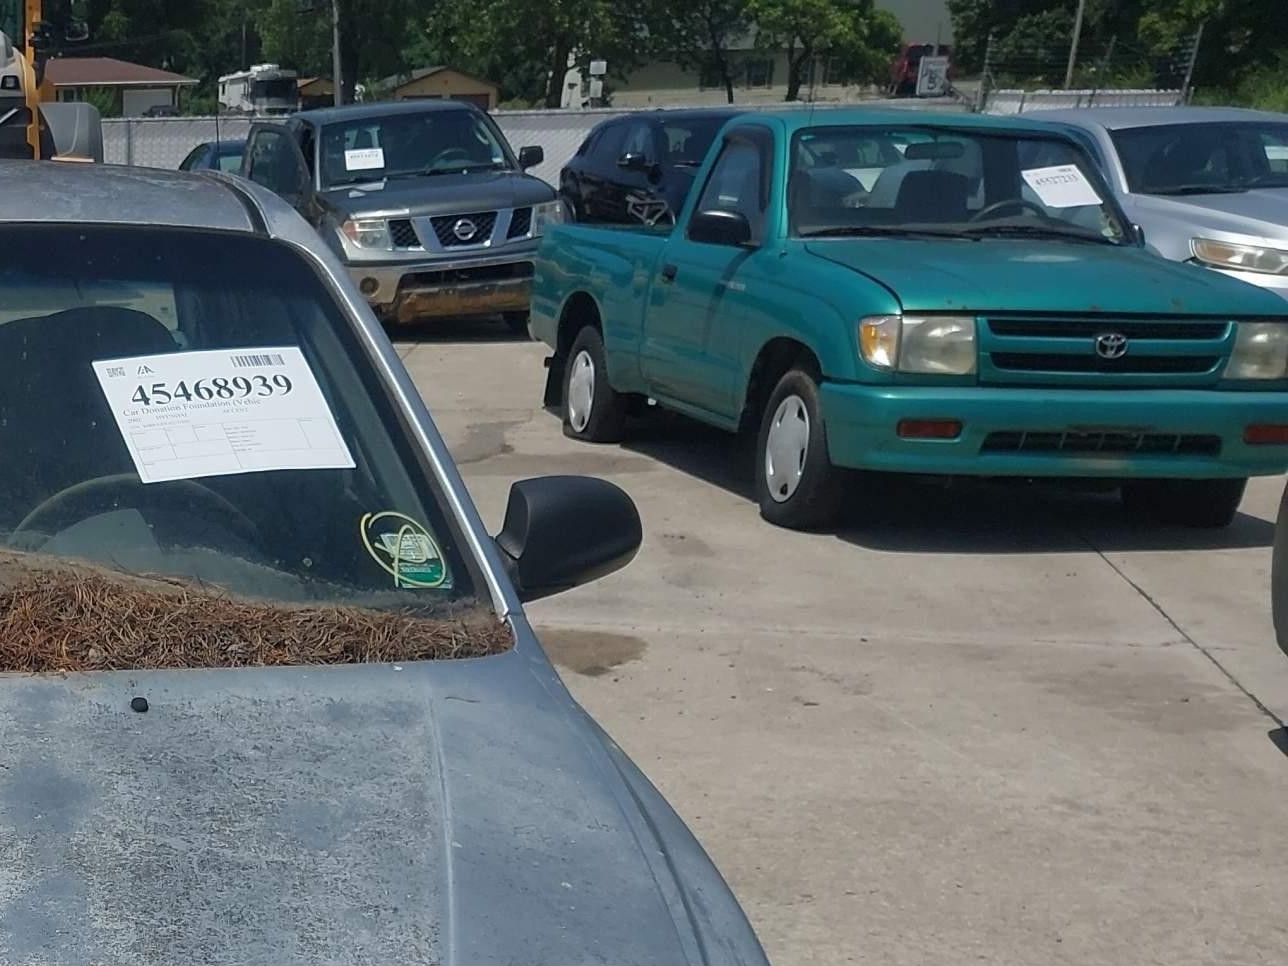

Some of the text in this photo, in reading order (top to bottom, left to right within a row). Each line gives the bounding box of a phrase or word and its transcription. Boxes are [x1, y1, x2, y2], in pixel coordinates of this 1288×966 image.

[131, 373, 293, 406] 45468939
[123, 408, 140, 417] Car
[141, 404, 182, 415] Donation
[183, 399, 231, 410] Foundation
